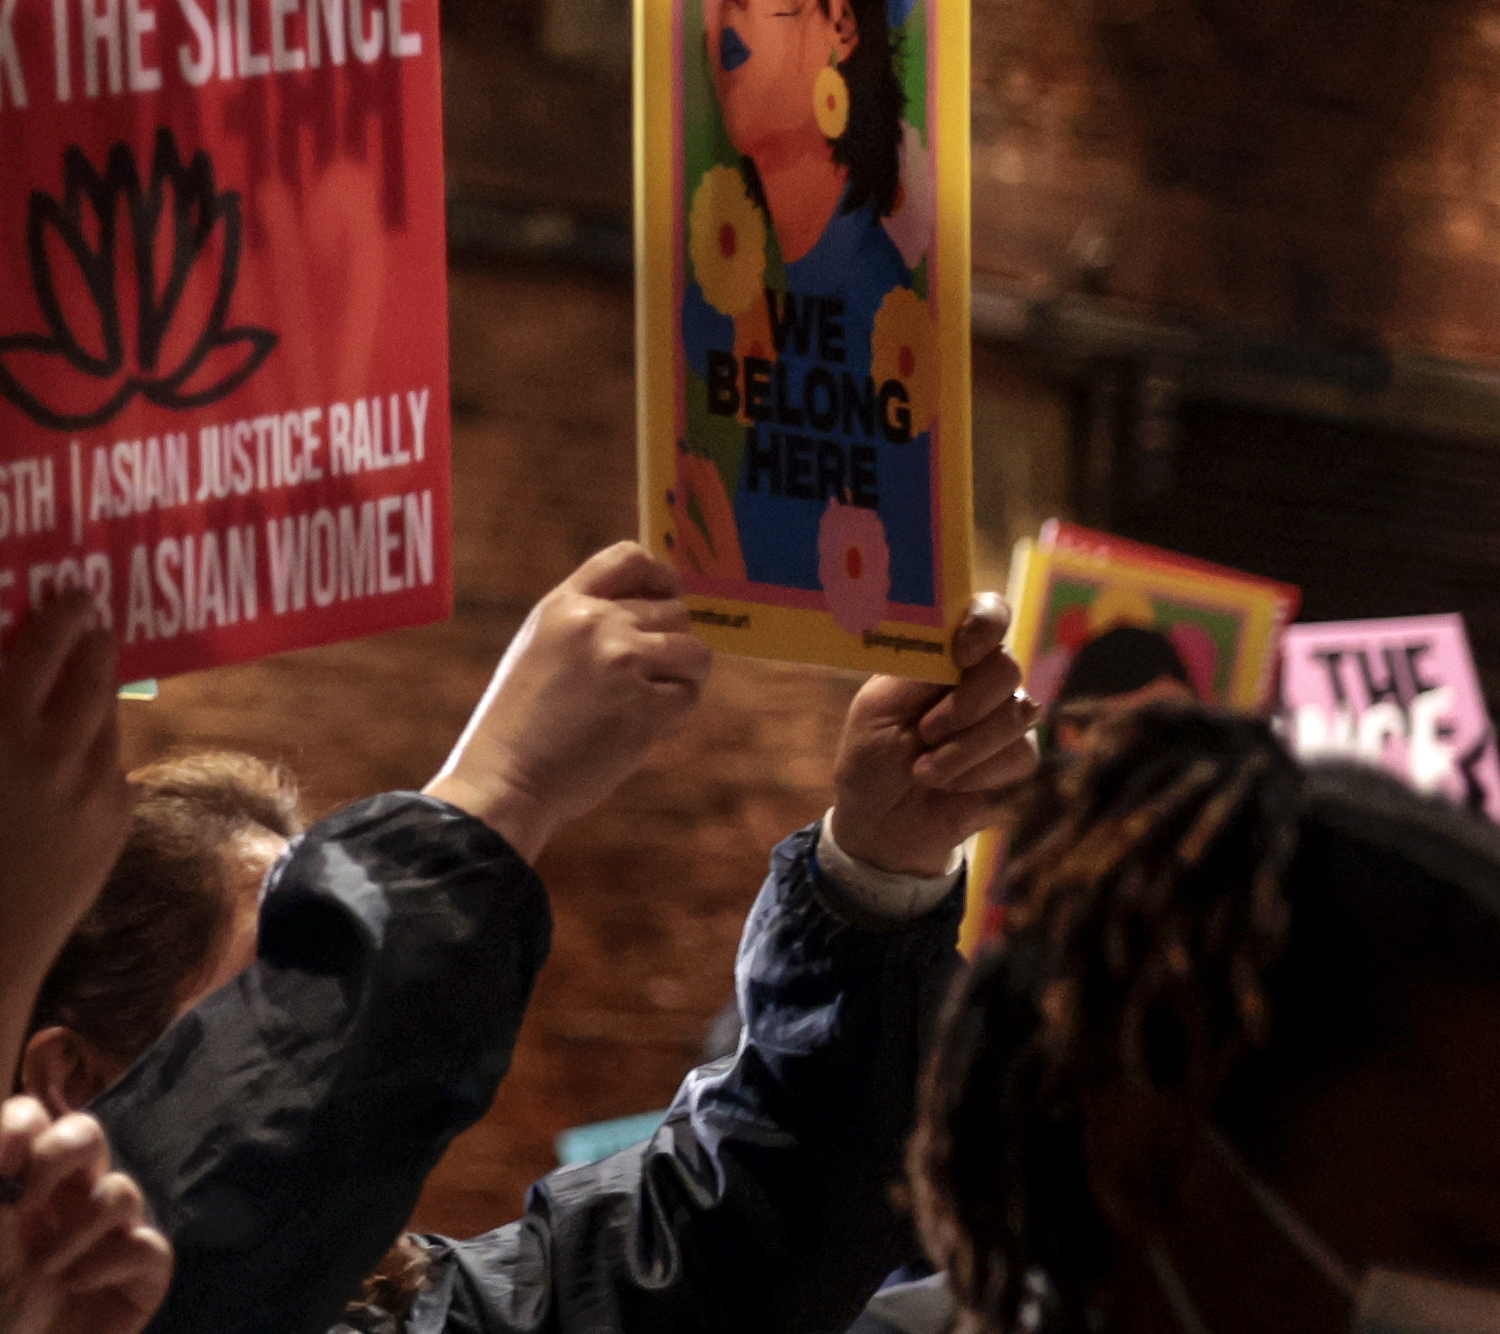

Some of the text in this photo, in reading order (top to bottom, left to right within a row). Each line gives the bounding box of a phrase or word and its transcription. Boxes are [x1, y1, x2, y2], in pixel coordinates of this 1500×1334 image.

[762, 286, 849, 364] WE
[706, 348, 913, 445] BELONG
[87, 427, 188, 523] ASIAN
[194, 407, 322, 499] JUSTICE
[327, 387, 432, 477] RALLY
[744, 425, 881, 509] HERE
[125, 527, 257, 648] ASIAN
[265, 490, 436, 617] WOMEN
